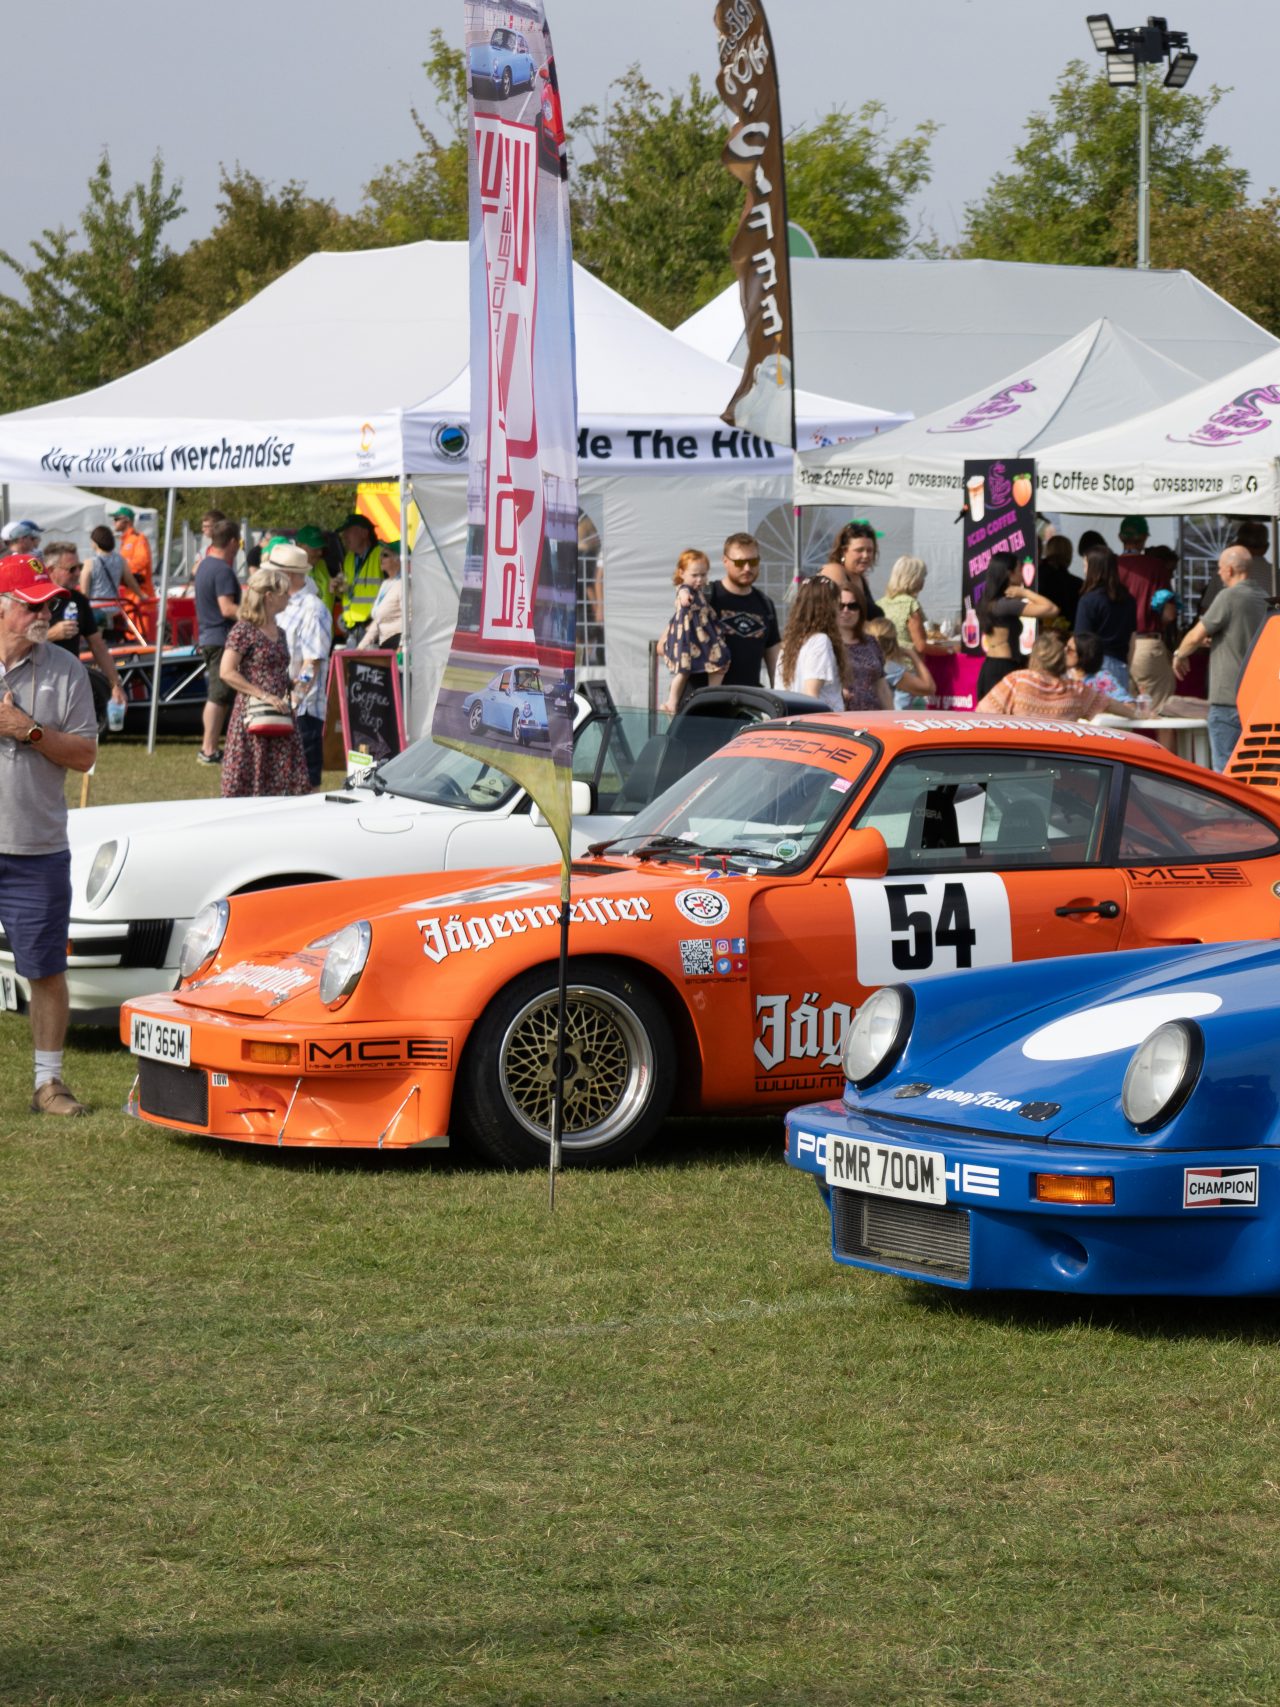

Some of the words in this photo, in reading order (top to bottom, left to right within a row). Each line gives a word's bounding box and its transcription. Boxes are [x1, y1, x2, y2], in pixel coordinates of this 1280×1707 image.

[171, 435, 295, 471] Merchandise
[626, 429, 699, 459] The
[711, 429, 776, 459] Hill
[824, 467, 864, 486] Coffee
[866, 469, 894, 489] Stop
[1052, 471, 1099, 492] Coffee
[1103, 473, 1135, 496] Stop
[1153, 475, 1224, 492] 07958319218
[1008, 530, 1025, 553] TEA
[1126, 867, 1244, 881] MCE
[882, 881, 977, 971] 54
[134, 1018, 153, 1052] WEY
[155, 1025, 186, 1060] 365M
[309, 1039, 449, 1062] MCE
[213, 1073, 229, 1085] TOW
[833, 1140, 871, 1184] RMR
[877, 1149, 935, 1195] 700M
[1189, 1180, 1254, 1196] CHAMPION
